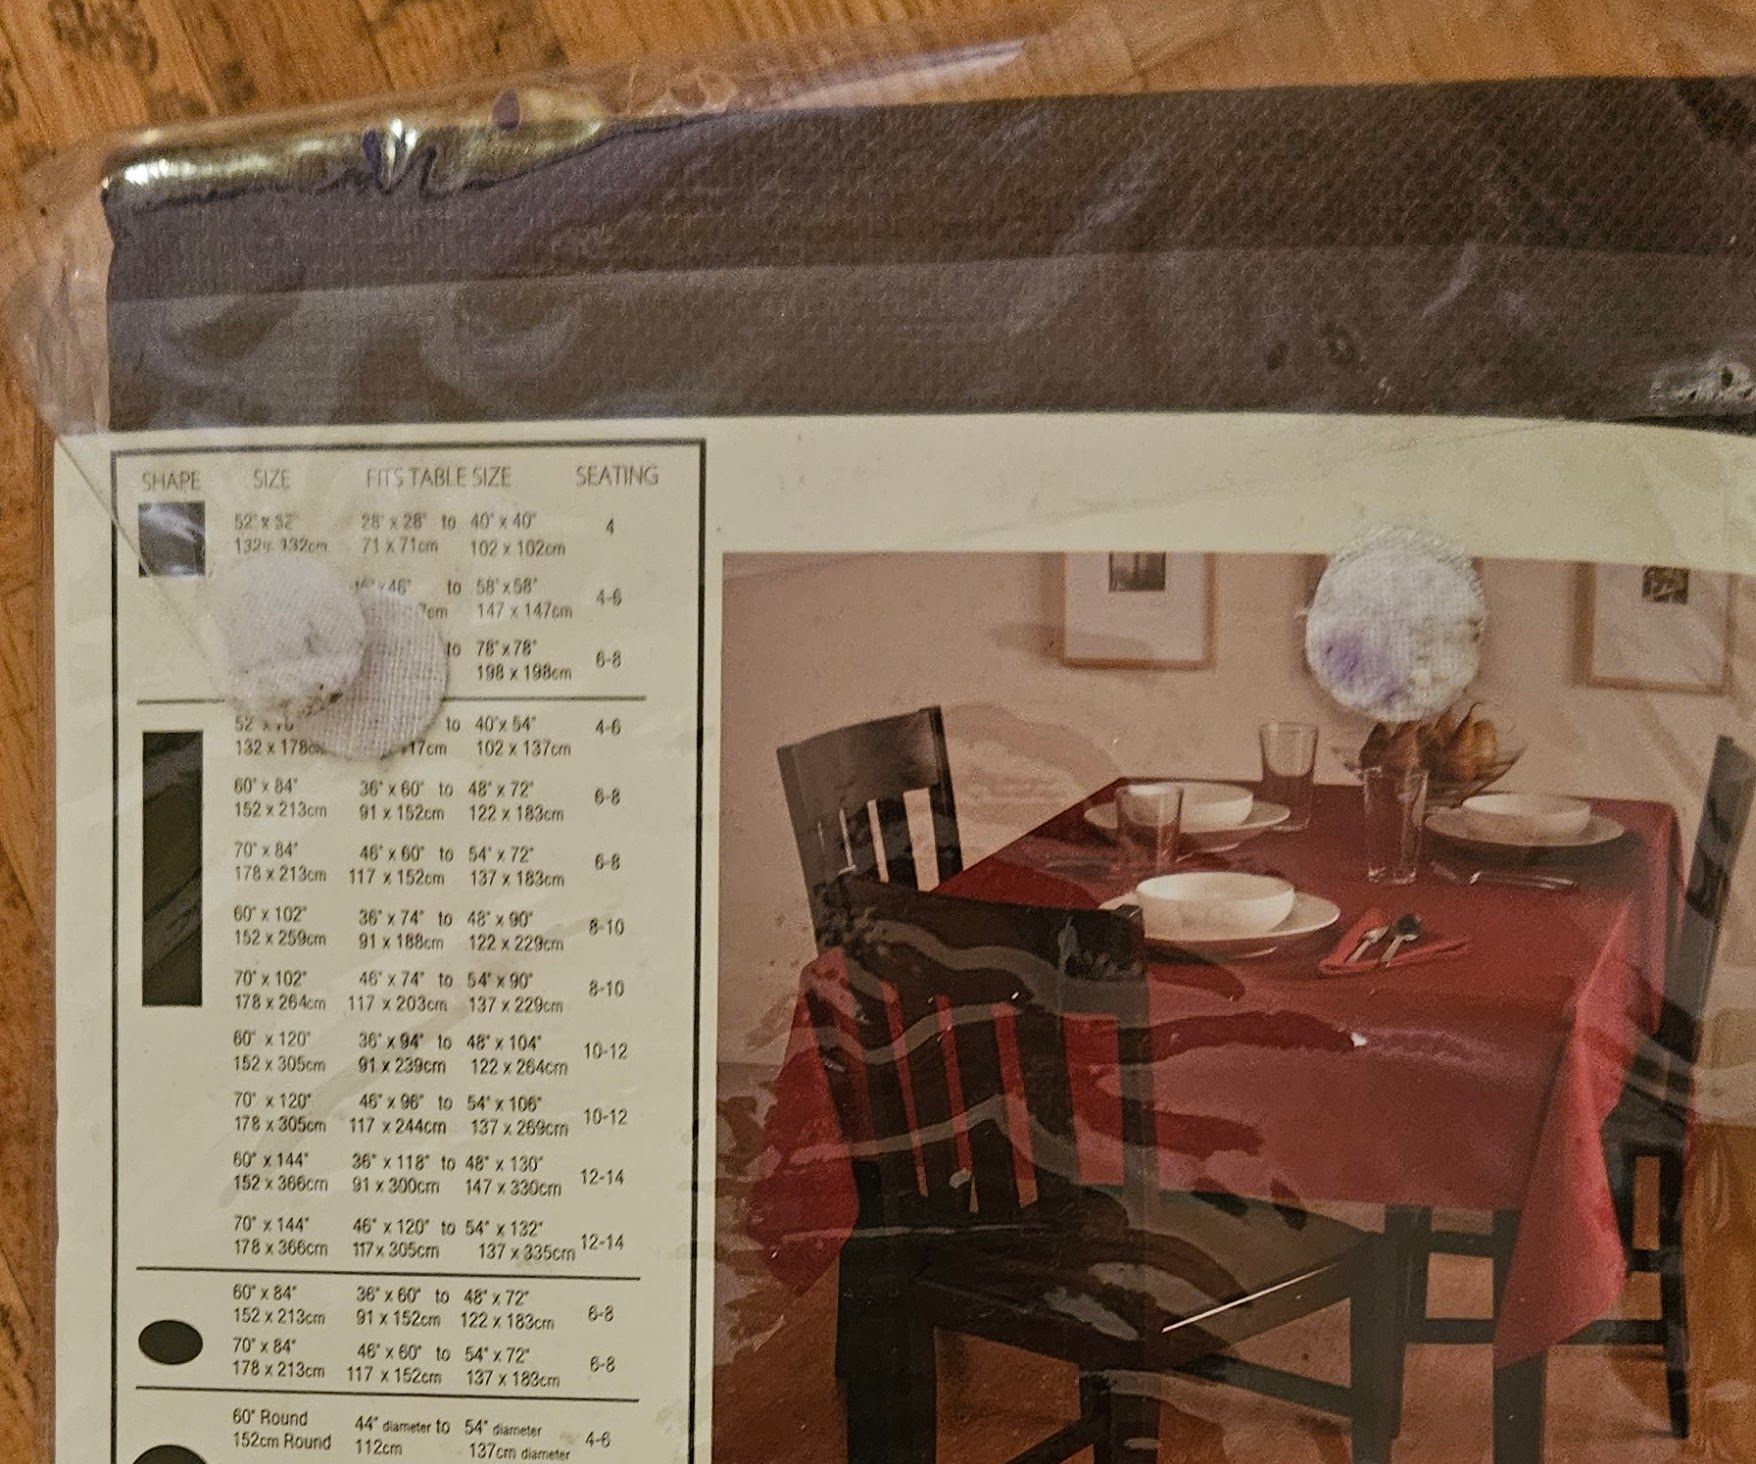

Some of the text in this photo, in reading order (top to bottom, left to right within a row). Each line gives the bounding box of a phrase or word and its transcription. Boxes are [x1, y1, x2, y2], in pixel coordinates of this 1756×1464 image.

[141, 469, 201, 492] SHAPE
[252, 467, 291, 492] SIZE
[366, 464, 511, 490] FITS TABLE SIZE
[575, 464, 659, 488] SEATING
[471, 538, 566, 558] 102 x 102cm
[588, 917, 625, 937] 8-10
[584, 1041, 628, 1061] 10-12
[580, 1167, 625, 1186] 12-14
[233, 1430, 332, 1451] 152cm Round
[355, 1437, 403, 1457] 112cm
